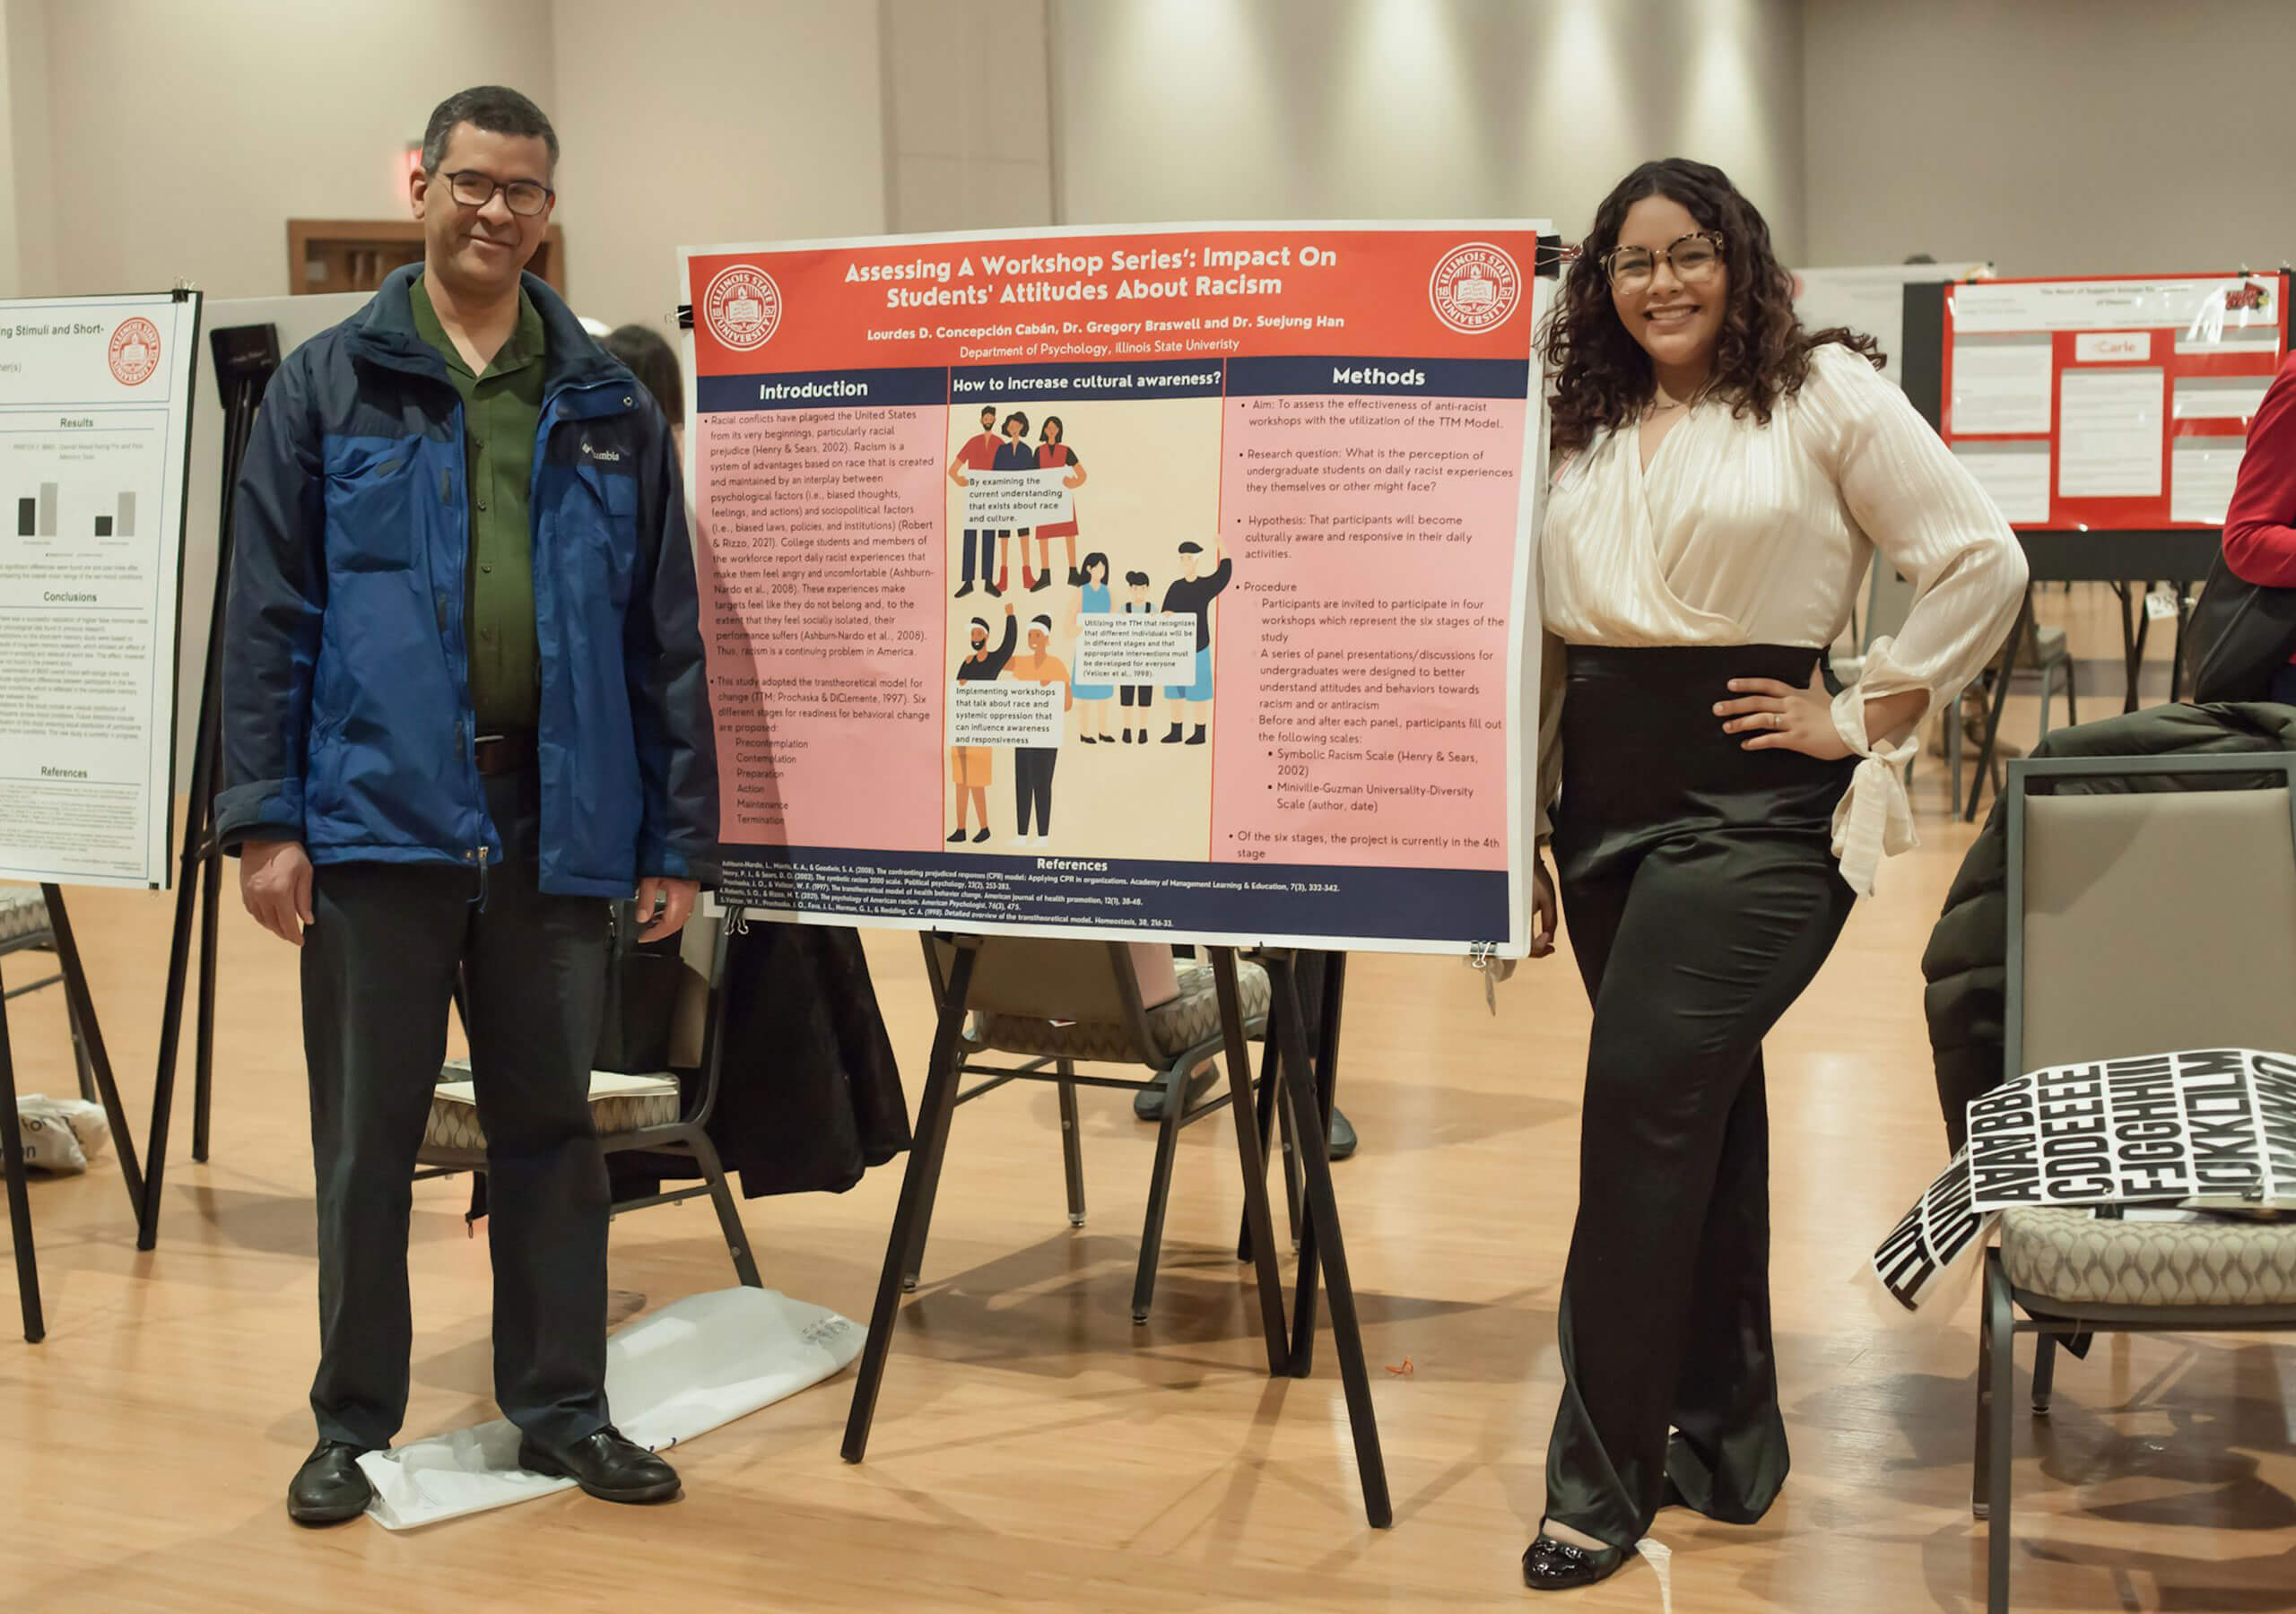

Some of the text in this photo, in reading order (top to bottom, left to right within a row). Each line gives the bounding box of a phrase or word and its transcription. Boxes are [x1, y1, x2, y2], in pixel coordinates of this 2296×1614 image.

[844, 257, 951, 287] Assessing
[957, 256, 974, 276] A
[980, 251, 1103, 280] Workshop
[1203, 245, 1291, 271] Impact
[1299, 246, 1336, 266] On
[1440, 252, 1511, 283] ILLINOIS STATE
[713, 273, 774, 305] ILLINOIS STATE
[886, 273, 1282, 308] Students' Attitudes About Racism
[1441, 300, 1506, 325] UNIVERSITY
[0, 323, 105, 340] ng Stimuli and Short-
[717, 319, 770, 342] UNIVERSITY
[866, 314, 1344, 341] Lourdes D. Concepción Cabán, Dr. Gregory Braswell and Dr. Suejung Han
[960, 344, 1023, 360] Department
[1025, 343, 1038, 355] of
[1039, 341, 1111, 358] Psychology,
[1115, 340, 1152, 353] Illinois
[1154, 338, 1183, 352] State
[952, 370, 1222, 392] How to increase cultural awareness?
[1332, 367, 1425, 386] Methods
[759, 379, 868, 399] Introduction
[1252, 398, 1487, 412] Aim: To assess the effectiveness of anti-racist
[59, 417, 94, 428] Results
[710, 408, 917, 425] Racial conflicts have plagued the United States
[709, 473, 883, 487] and maintained by an interplay between
[969, 477, 1040, 488] By examining the
[1246, 480, 1437, 494] they themselves or other might face?
[710, 488, 900, 505] psychological factors (i.e., biased thoughts,
[969, 489, 1063, 499] current understanding
[969, 502, 986, 510] that
[987, 501, 1011, 510] exists
[1012, 501, 1037, 509] about
[968, 514, 1017, 523] and culture.
[1243, 580, 1297, 592] Procedure
[43, 590, 98, 603] Conclusions
[1260, 630, 1289, 644] study
[1259, 647, 1493, 663] A series of panel presentations/discussions for
[1093, 660, 1131, 668] developed
[1132, 659, 1144, 667] for
[1259, 664, 1465, 680] undergraduates were designed to better
[955, 684, 1056, 698] Implementing workshops
[955, 699, 971, 707] that
[972, 699, 987, 707] talk
[988, 699, 1011, 707] about
[1032, 699, 1049, 708] and
[955, 711, 1052, 721] systemic oppression that
[970, 723, 1004, 732] influence
[1006, 725, 1049, 733] awareness
[954, 735, 1029, 747] and responsiveness
[40, 765, 88, 778] References
[1277, 764, 1309, 778] 2002)
[1276, 781, 1474, 798] Miniville-Guzman Universality-Diversity
[1237, 848, 1265, 861] stage
[1036, 858, 1108, 872] References
